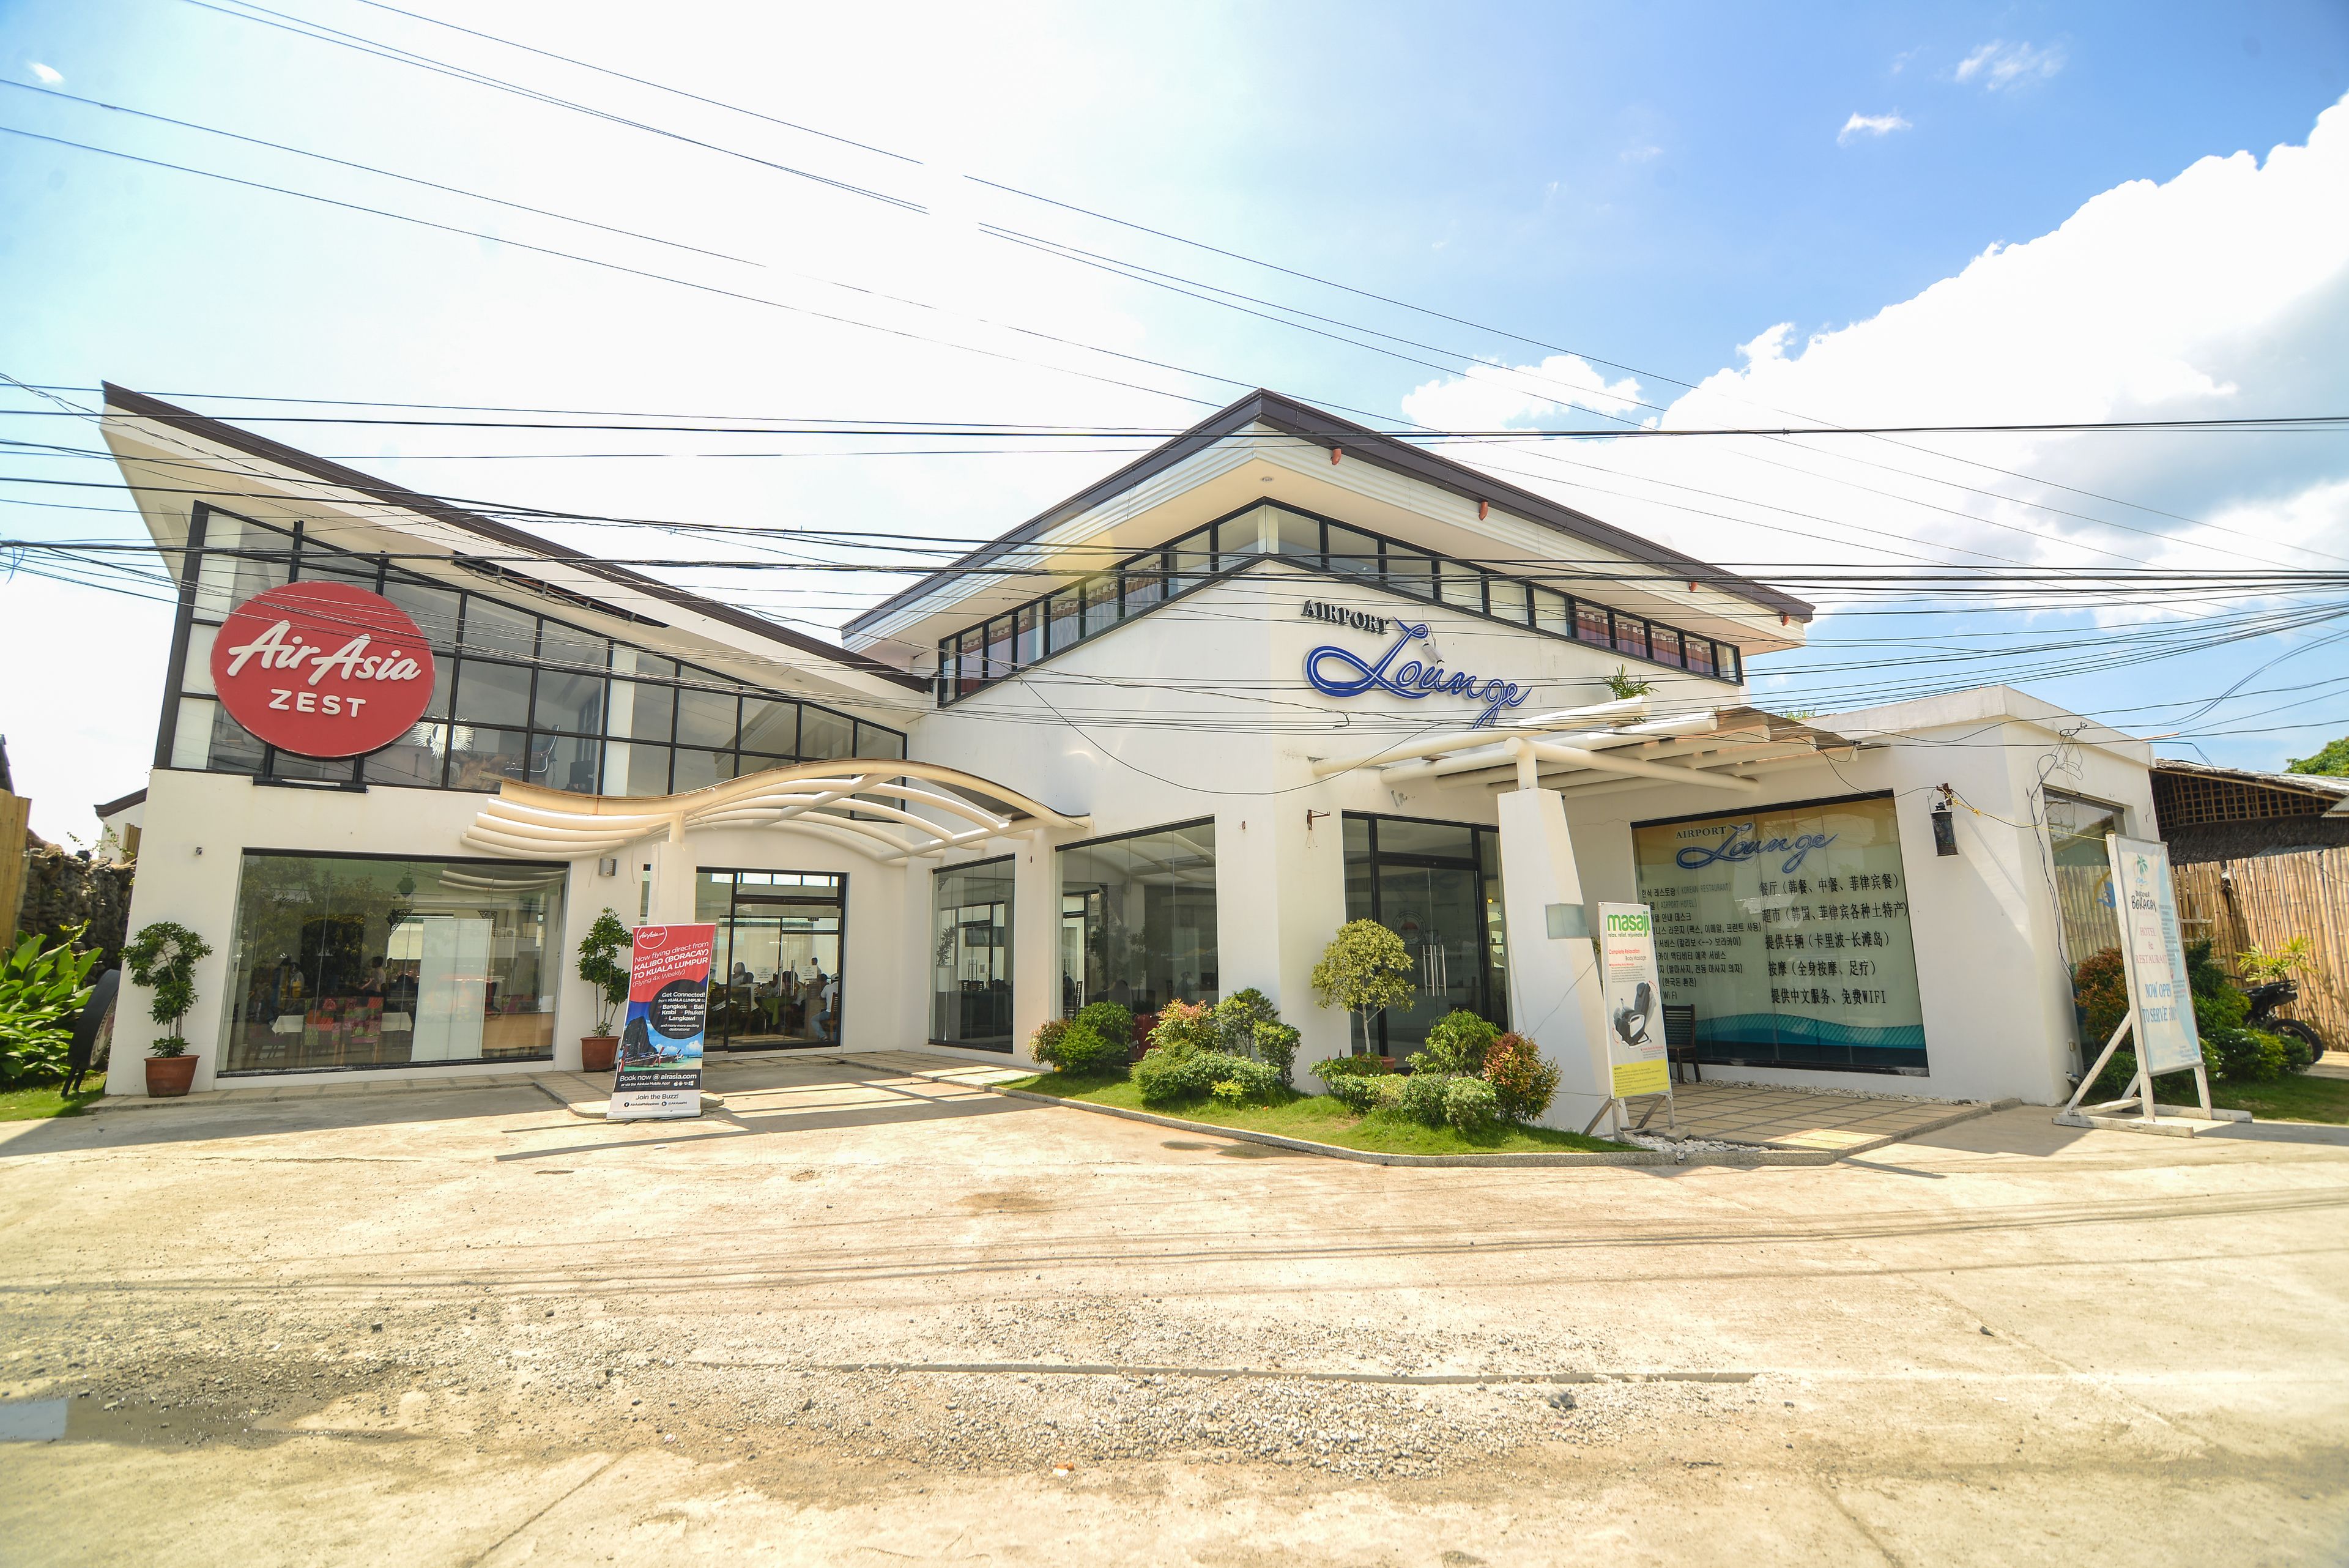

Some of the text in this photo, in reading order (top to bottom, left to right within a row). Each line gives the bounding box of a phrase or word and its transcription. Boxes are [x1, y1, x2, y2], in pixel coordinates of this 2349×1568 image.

[1301, 599, 1389, 635] AIRPORT
[227, 619, 421, 686] AirAsia
[1302, 616, 1532, 729] Lounge
[269, 688, 366, 718] ZEST
[1676, 826, 1727, 839] AIRPORT
[1676, 822, 1838, 874] Lounge
[1642, 888, 1652, 898] 한식
[1654, 887, 1675, 897] 레스토랑
[1607, 911, 1650, 937] masaji
[1662, 913, 1672, 922] 안내
[1669, 926, 1685, 935] 라운지
[1727, 923, 1744, 932] 프린트
[1747, 922, 1761, 932] 사용)
[2139, 927, 2156, 936] HOTEL
[1677, 938, 1696, 948] (칼리보
[1715, 936, 1741, 946] 보라카이)
[634, 954, 651, 963] Now
[651, 949, 670, 959] flying
[672, 944, 691, 954] direct
[634, 948, 709, 971] KALIBO (BORACAY)
[1671, 951, 1693, 960] 액티비티
[1709, 951, 1726, 960] 서비스
[646, 965, 673, 976] KUALA
[674, 957, 708, 968] LUMPUR
[1695, 965, 1706, 973] 전동
[1709, 964, 1726, 973] 마사지
[1728, 964, 1742, 974] 의자)
[632, 978, 651, 988] (Flying
[662, 969, 685, 979] Weekly)
[1662, 977, 1696, 987] (한국돈 환전)
[2145, 981, 2158, 998] NOW
